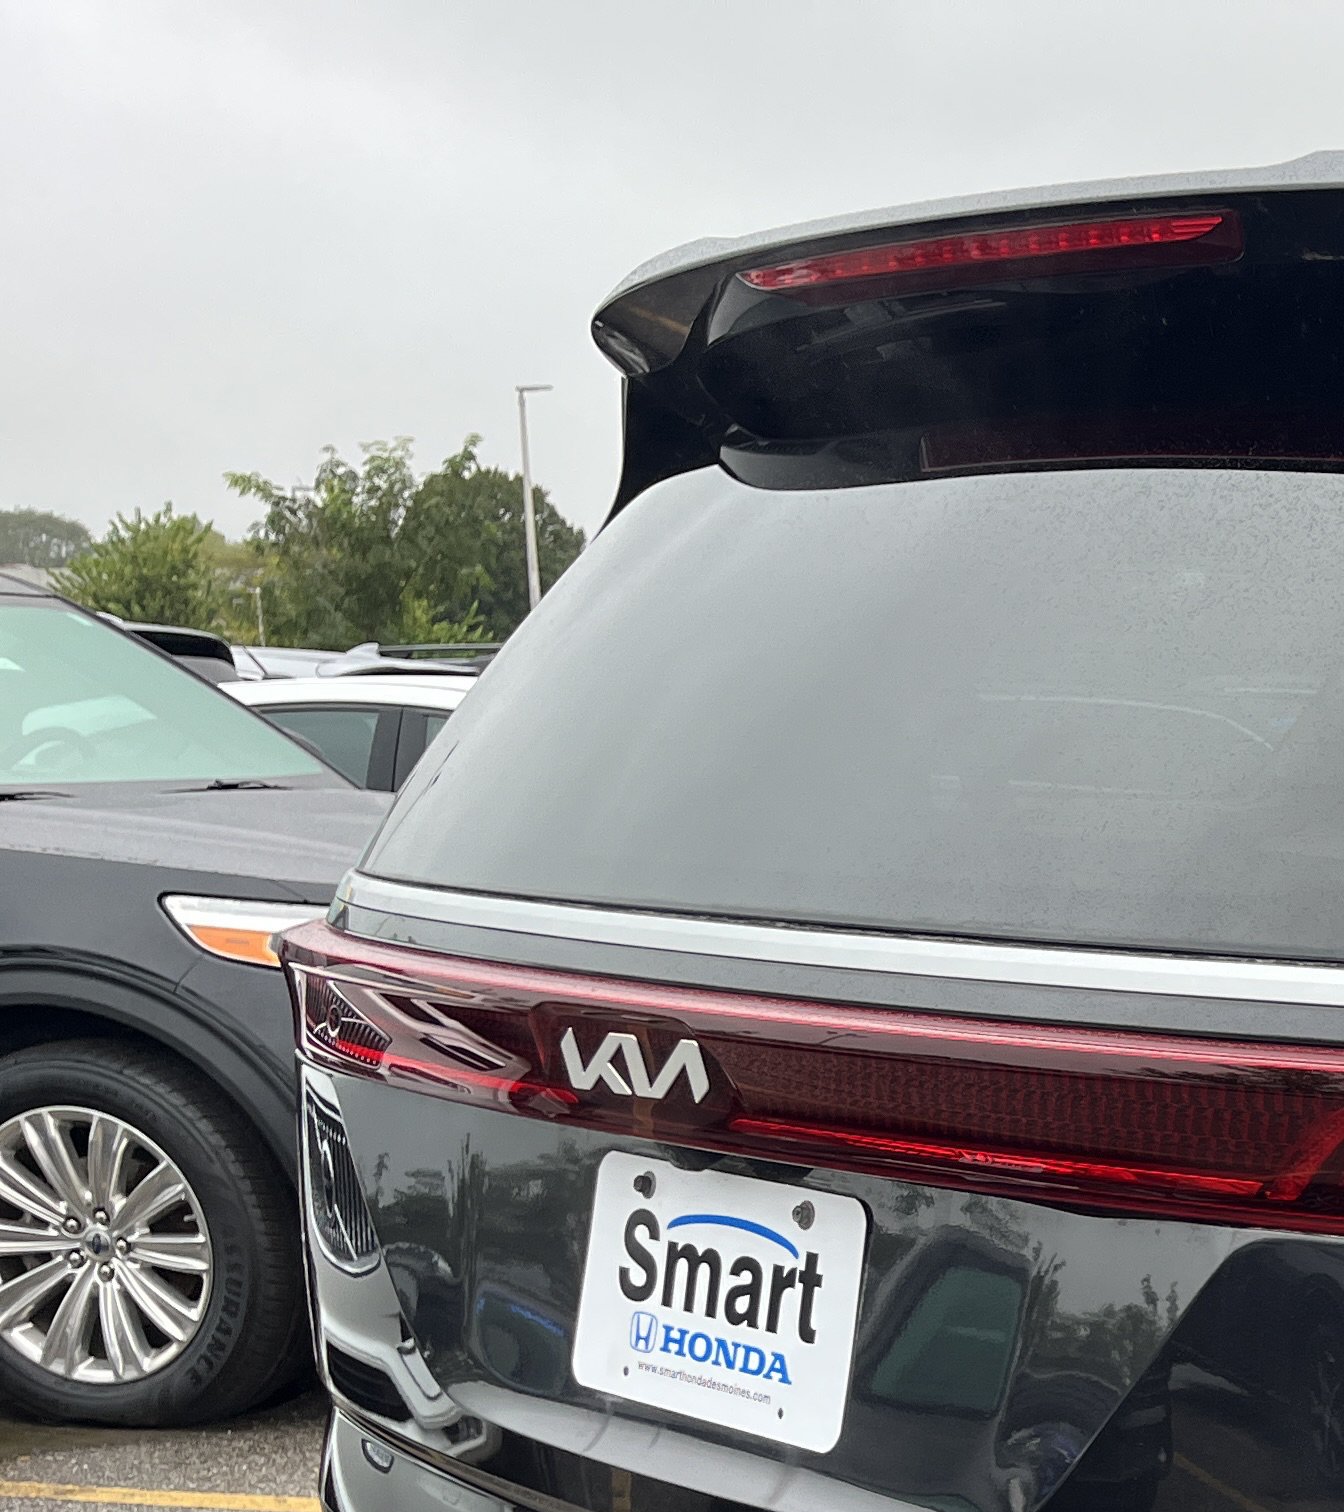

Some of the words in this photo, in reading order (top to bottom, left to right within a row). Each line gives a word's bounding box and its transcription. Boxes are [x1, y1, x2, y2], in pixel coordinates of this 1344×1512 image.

[559, 1024, 710, 1105] KIA
[618, 1208, 824, 1345] Smart
[637, 1360, 772, 1405] www.smarthondadesmoines.com
[659, 1324, 793, 1386] HONDA
